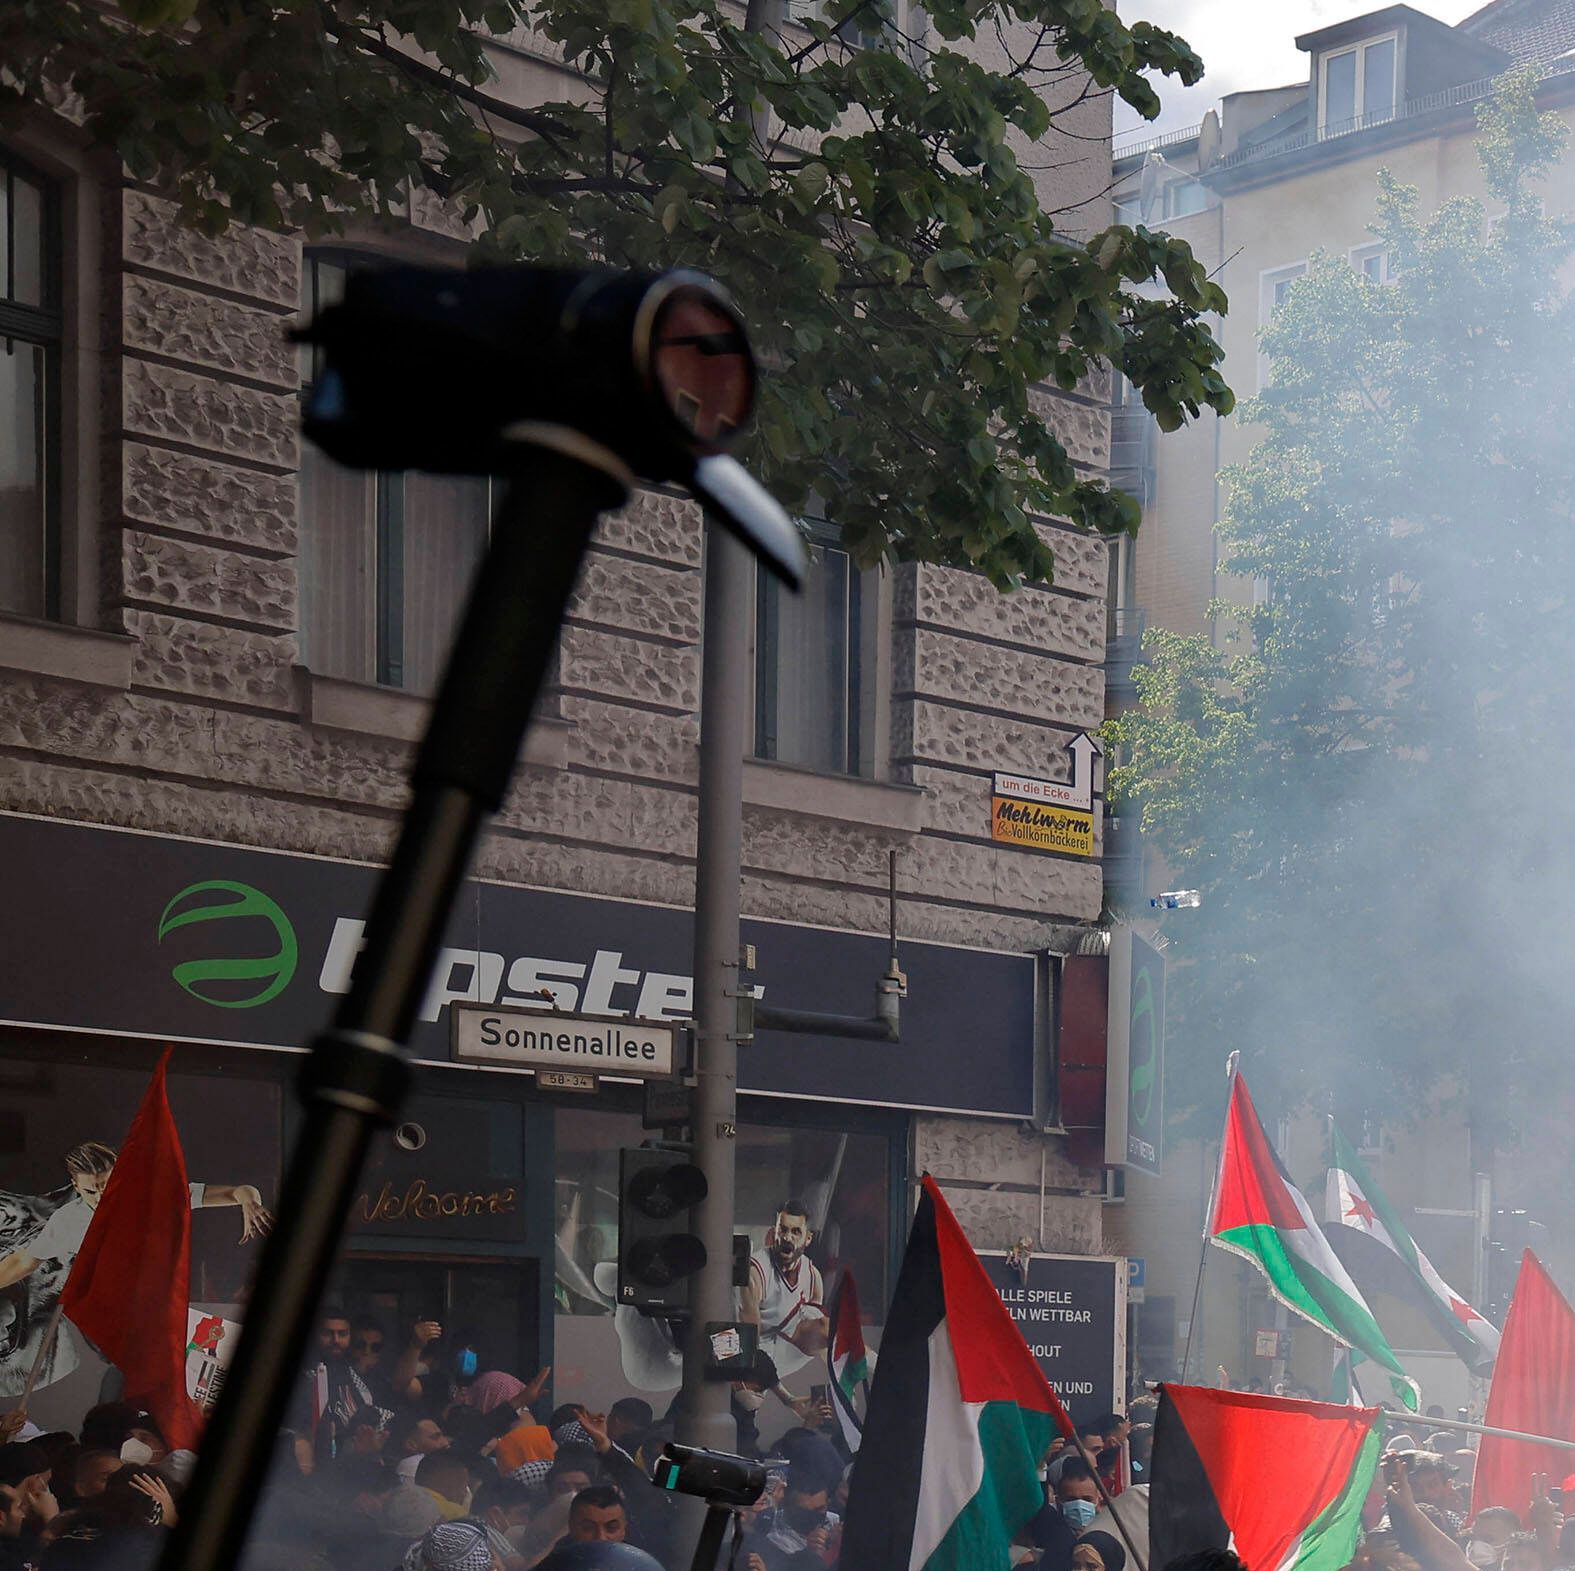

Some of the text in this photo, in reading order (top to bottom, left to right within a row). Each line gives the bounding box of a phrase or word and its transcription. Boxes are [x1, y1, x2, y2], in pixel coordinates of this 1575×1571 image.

[1002, 780, 1020, 791] um
[1023, 782, 1040, 795] die
[1043, 785, 1070, 800] Ecke
[480, 1017, 656, 1061] Sonnenallee
[1027, 1290, 1073, 1305] SPIELE
[1029, 1309, 1092, 1324] WETTBAR
[1065, 1382, 1093, 1394] UND
